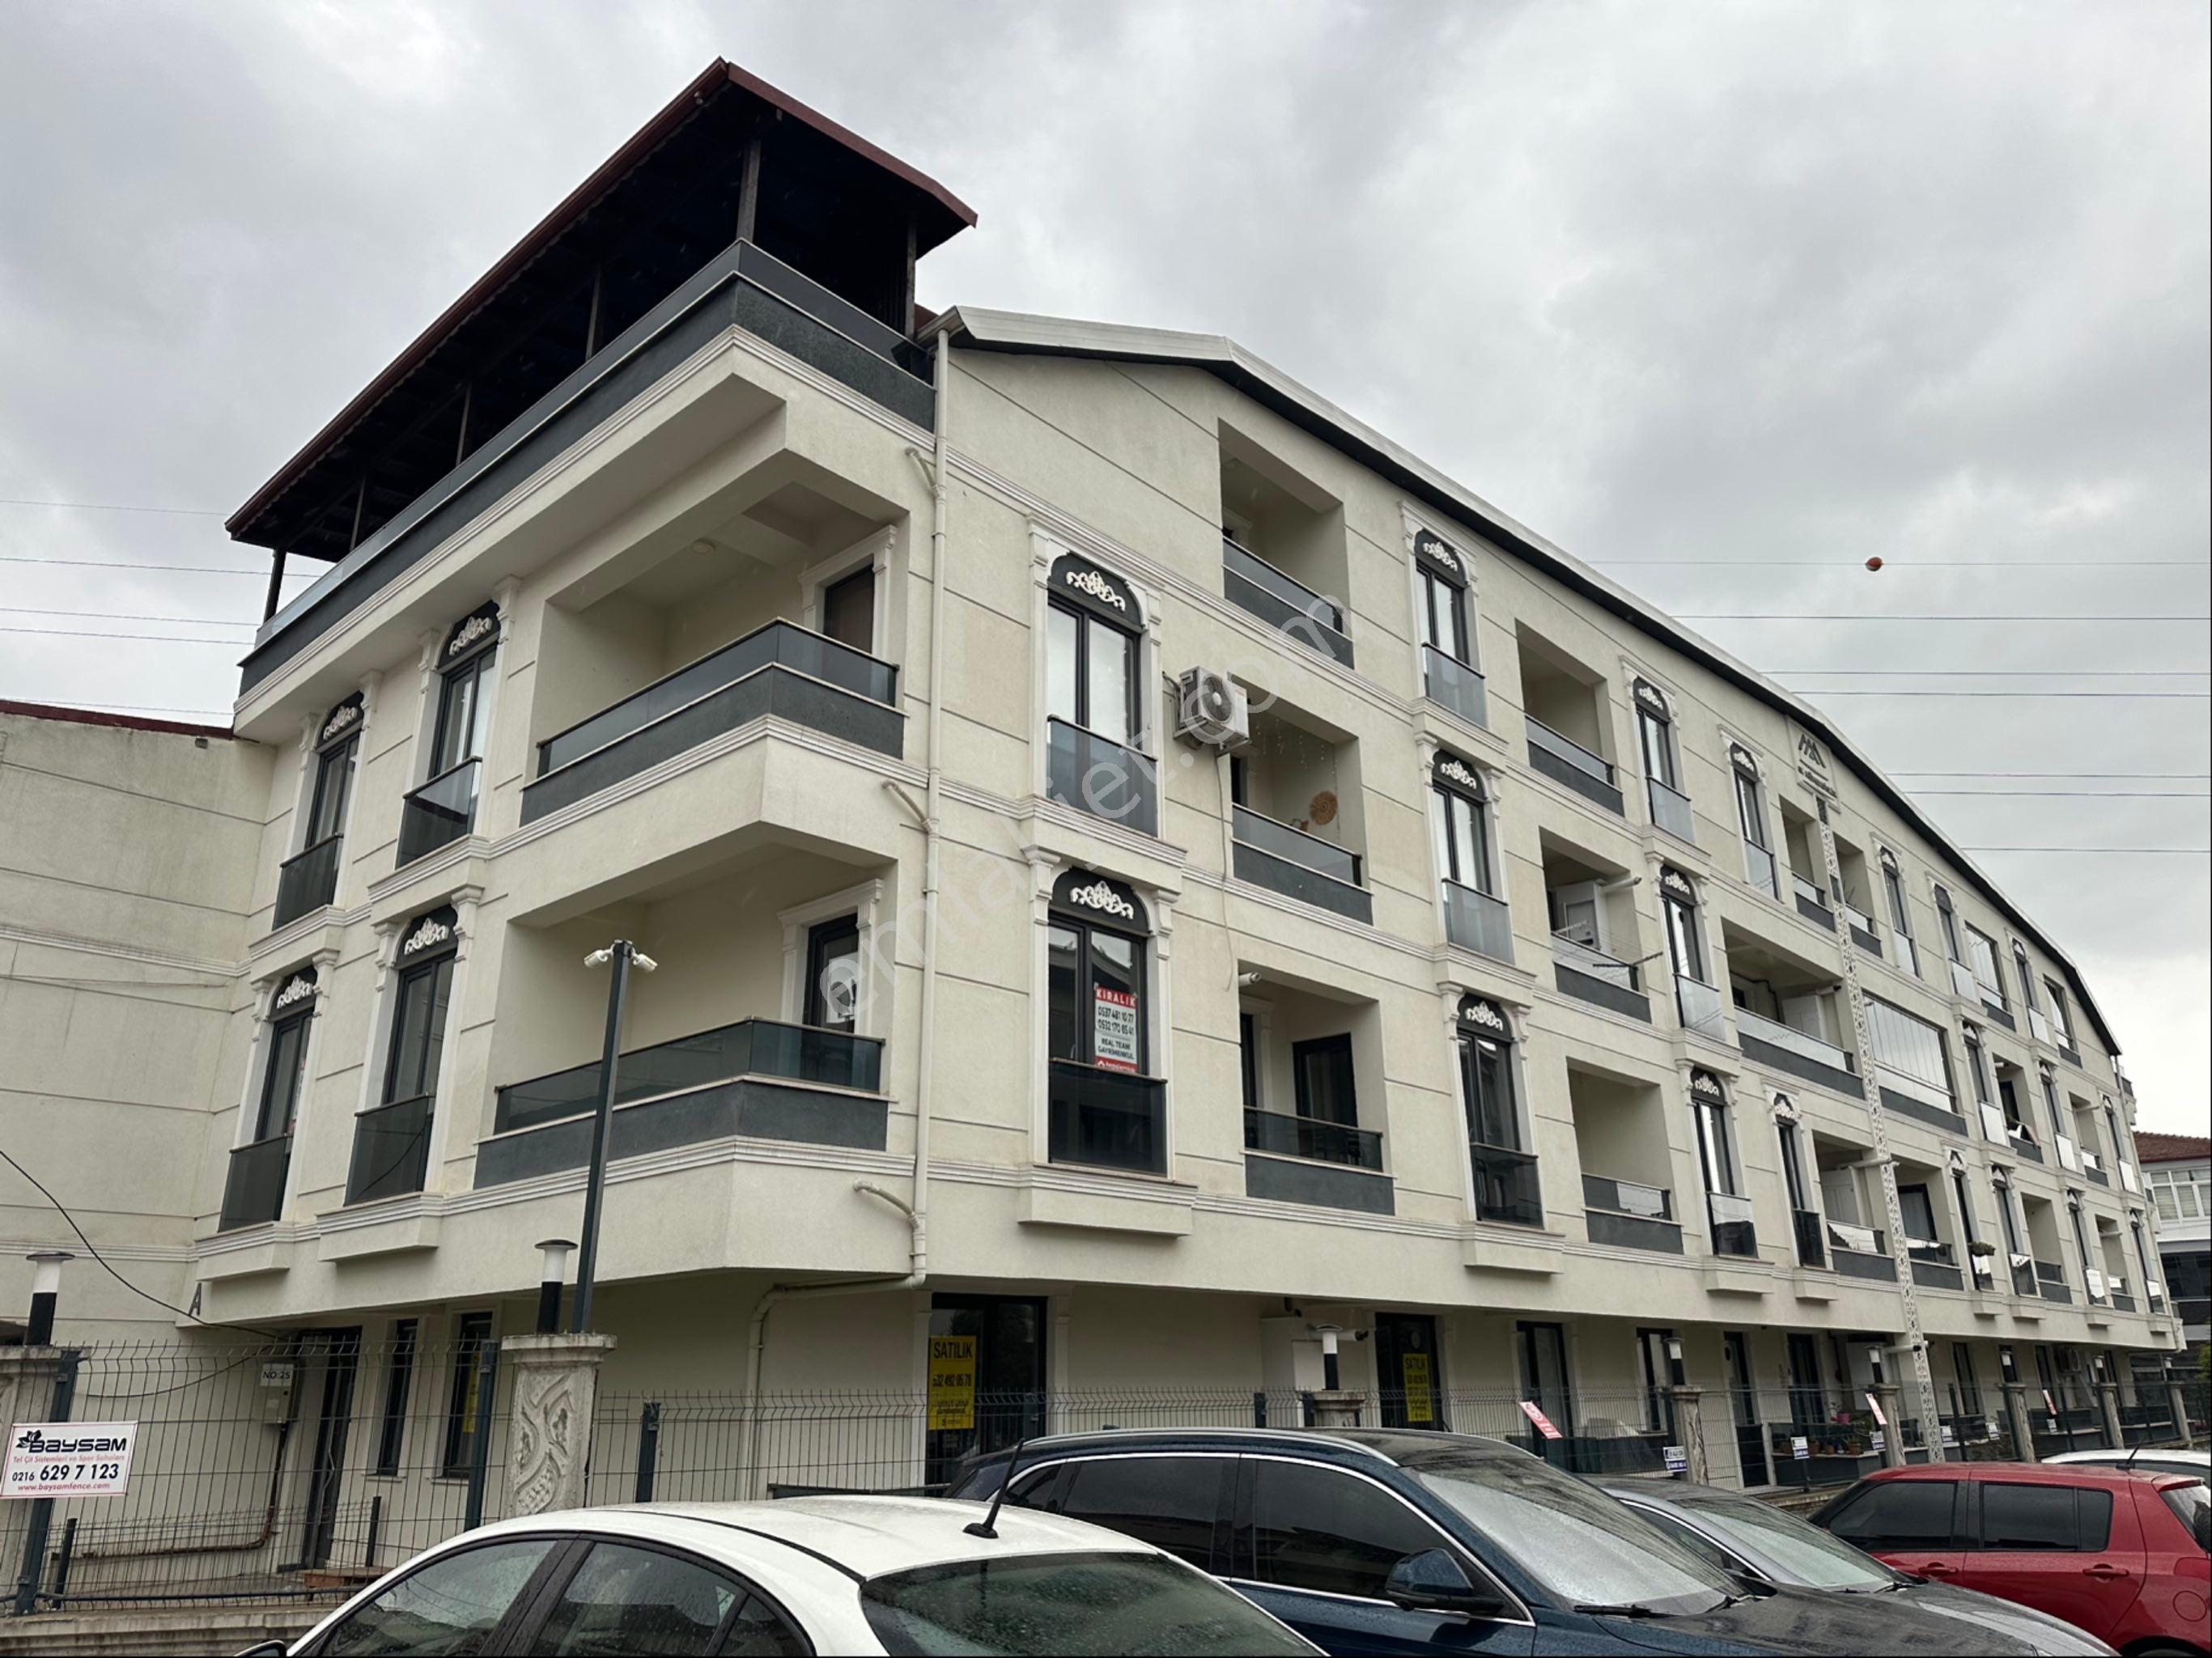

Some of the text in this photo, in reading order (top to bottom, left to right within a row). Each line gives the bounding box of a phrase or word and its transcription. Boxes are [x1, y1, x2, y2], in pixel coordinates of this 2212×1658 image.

[188, 1282, 202, 1316] A
[933, 1341, 973, 1359] SATILIK
[12, 1464, 119, 1482] 0216 629 7 123
[18, 1482, 110, 1491] www.baysamfence.com
